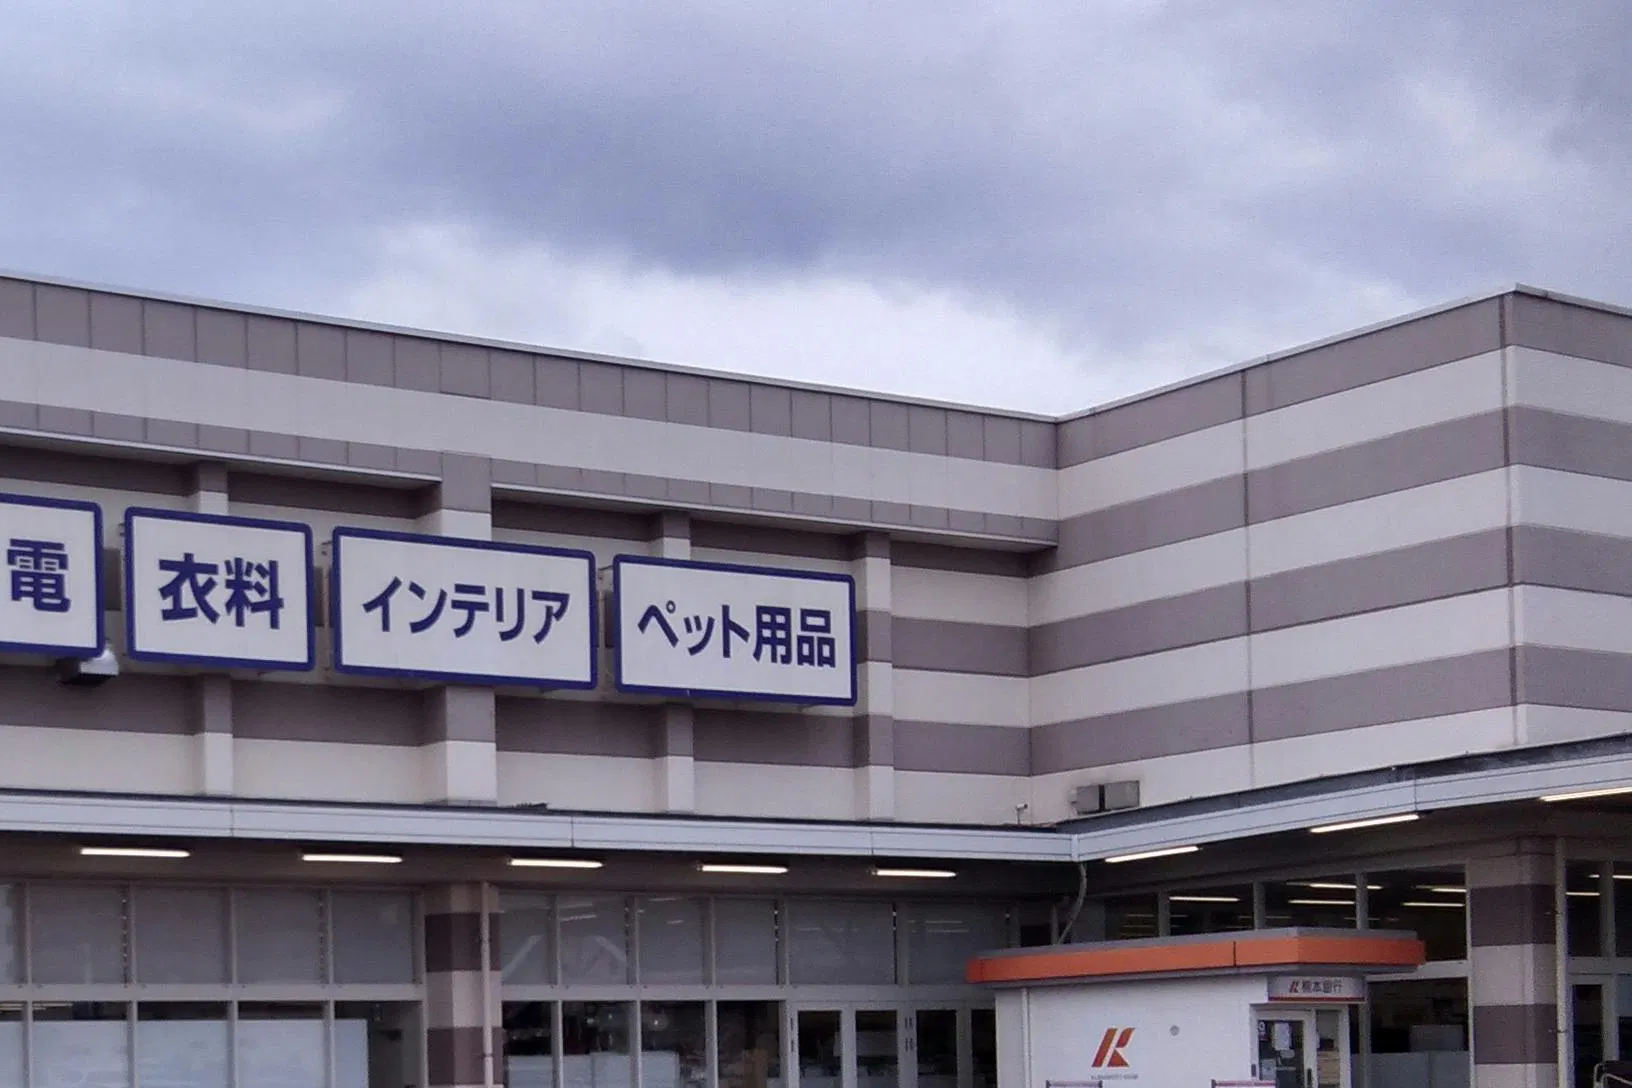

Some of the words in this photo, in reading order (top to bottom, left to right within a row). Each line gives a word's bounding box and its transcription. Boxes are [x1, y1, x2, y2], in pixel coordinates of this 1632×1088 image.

[158, 552, 284, 630] 衣料
[363, 576, 571, 645] インテリア
[637, 600, 836, 669] ペット用品
